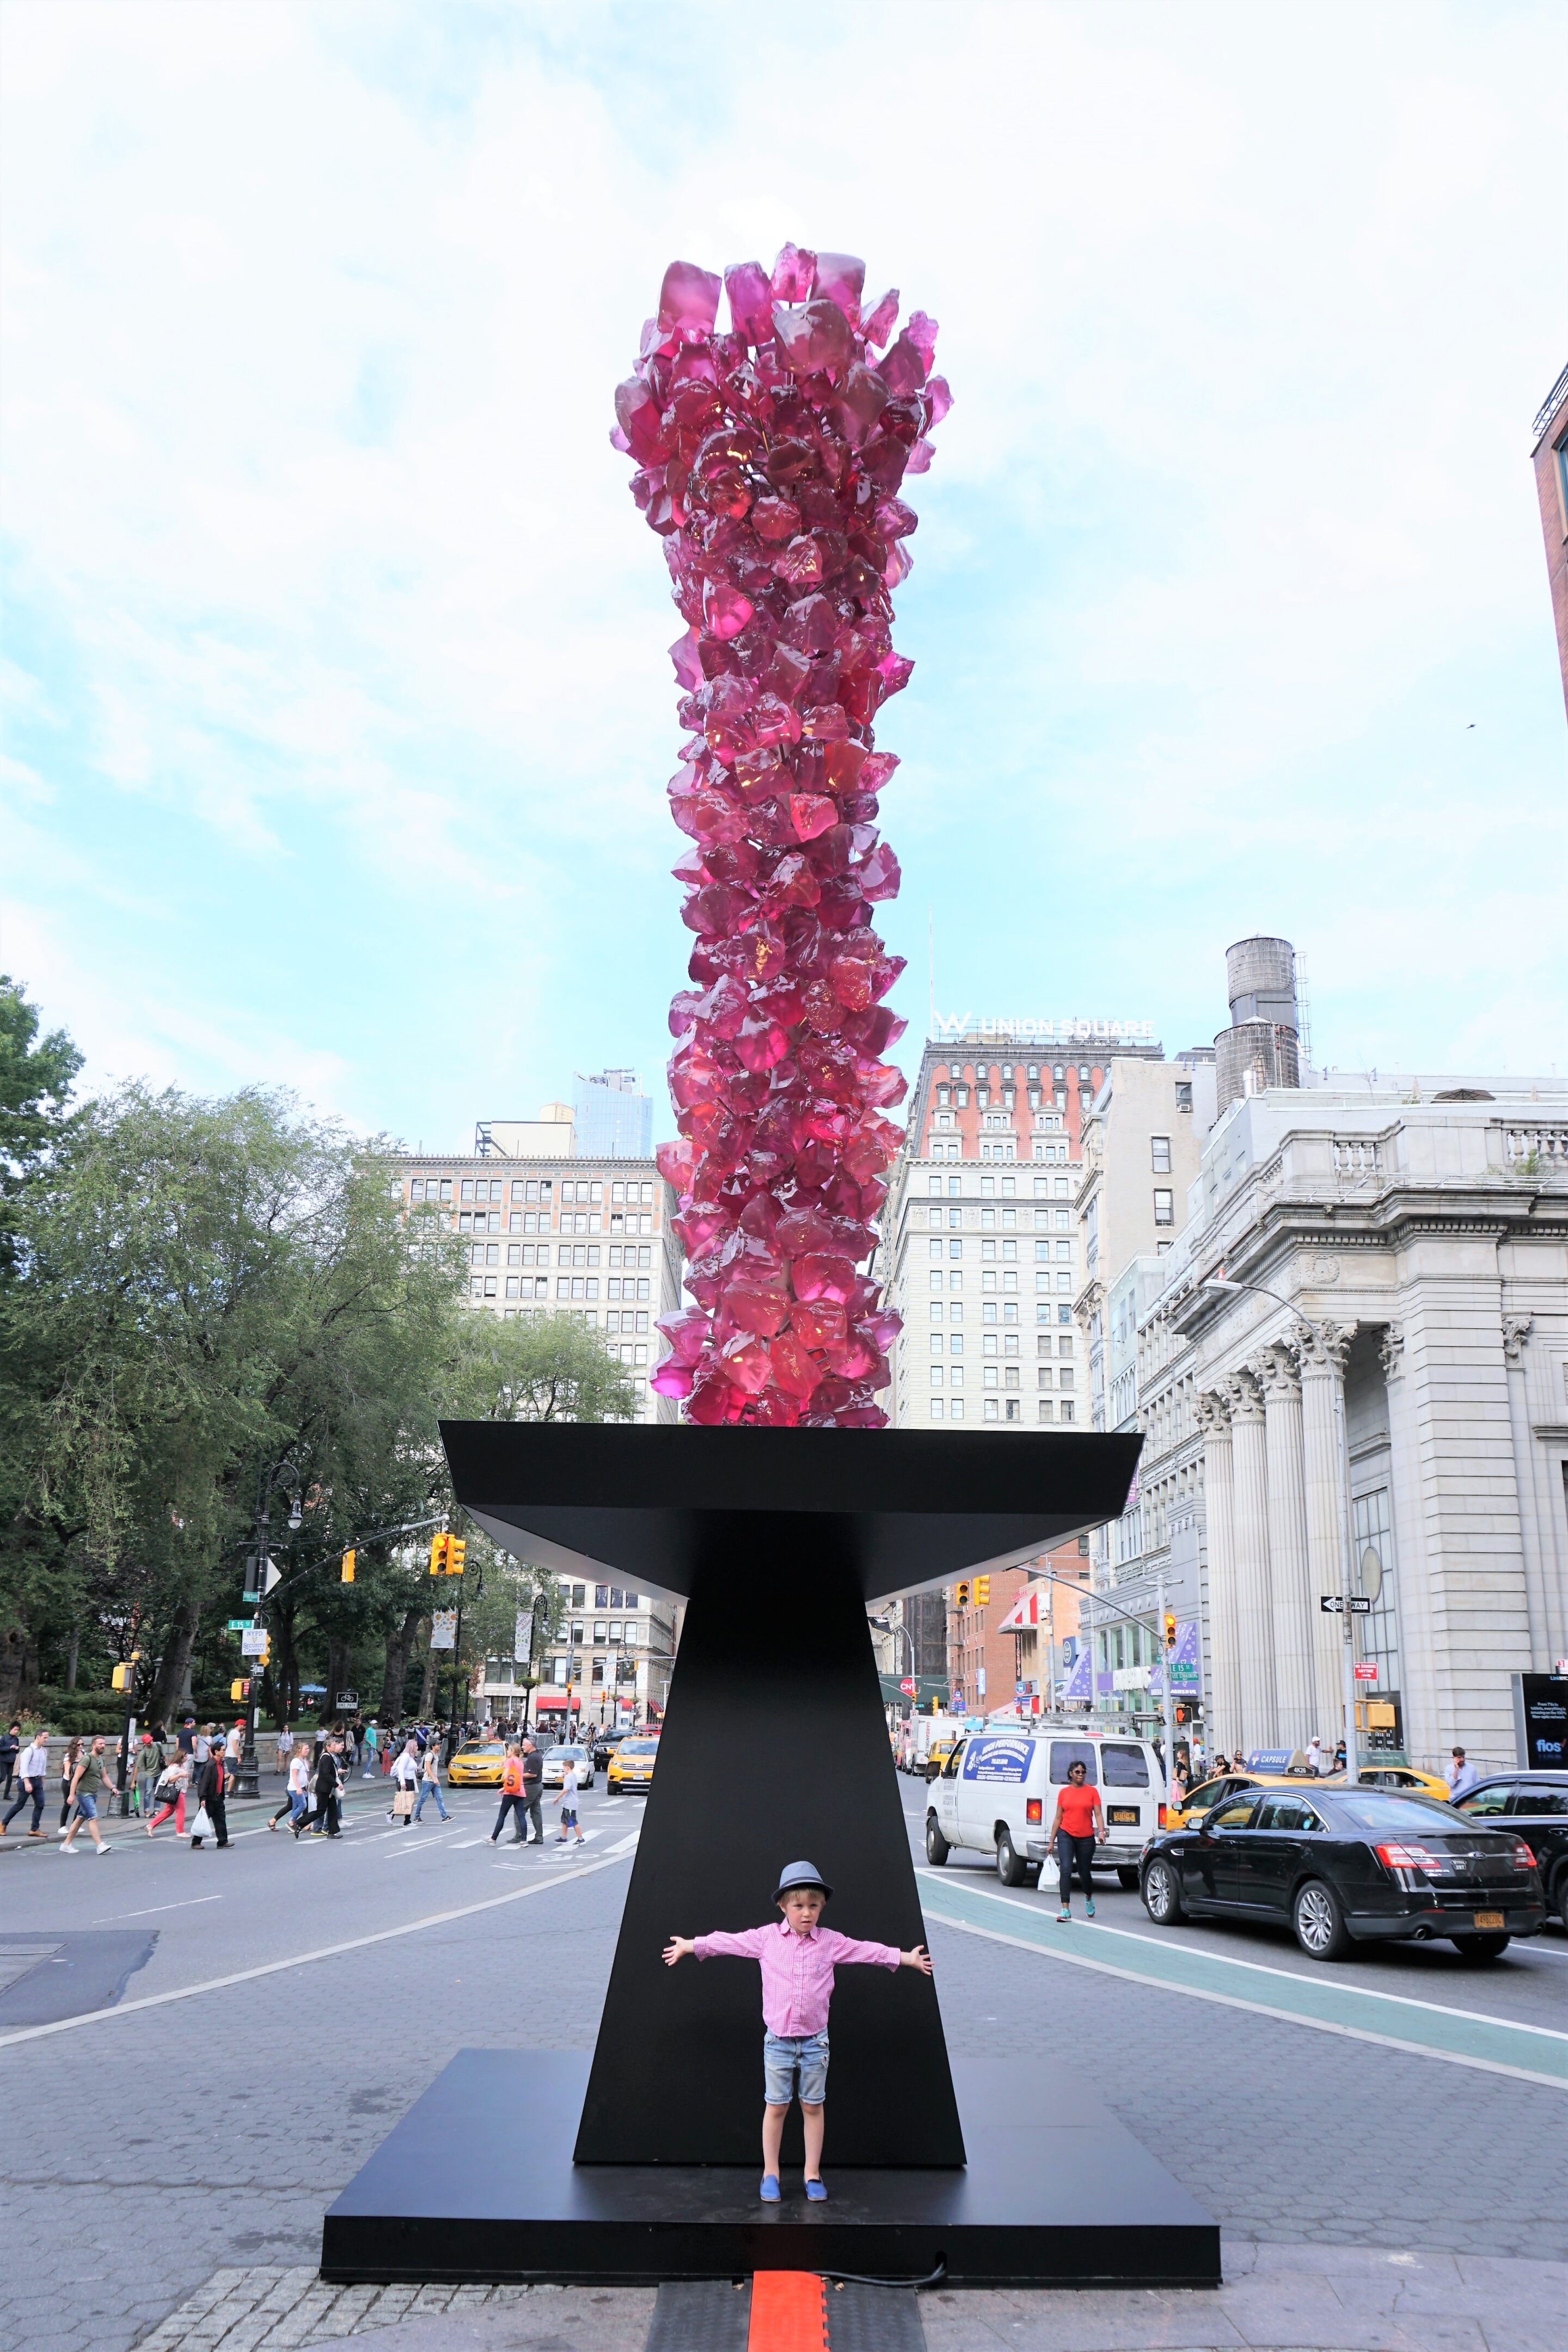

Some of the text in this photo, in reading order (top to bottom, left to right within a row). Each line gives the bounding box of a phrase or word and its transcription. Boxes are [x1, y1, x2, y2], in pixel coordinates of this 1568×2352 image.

[933, 1010, 1155, 1039] W UNION SQUARE
[982, 1738, 1030, 1756] HIGH PERFORMANCE
[1536, 1739, 1561, 1753] fios
[506, 1774, 514, 1787] S
